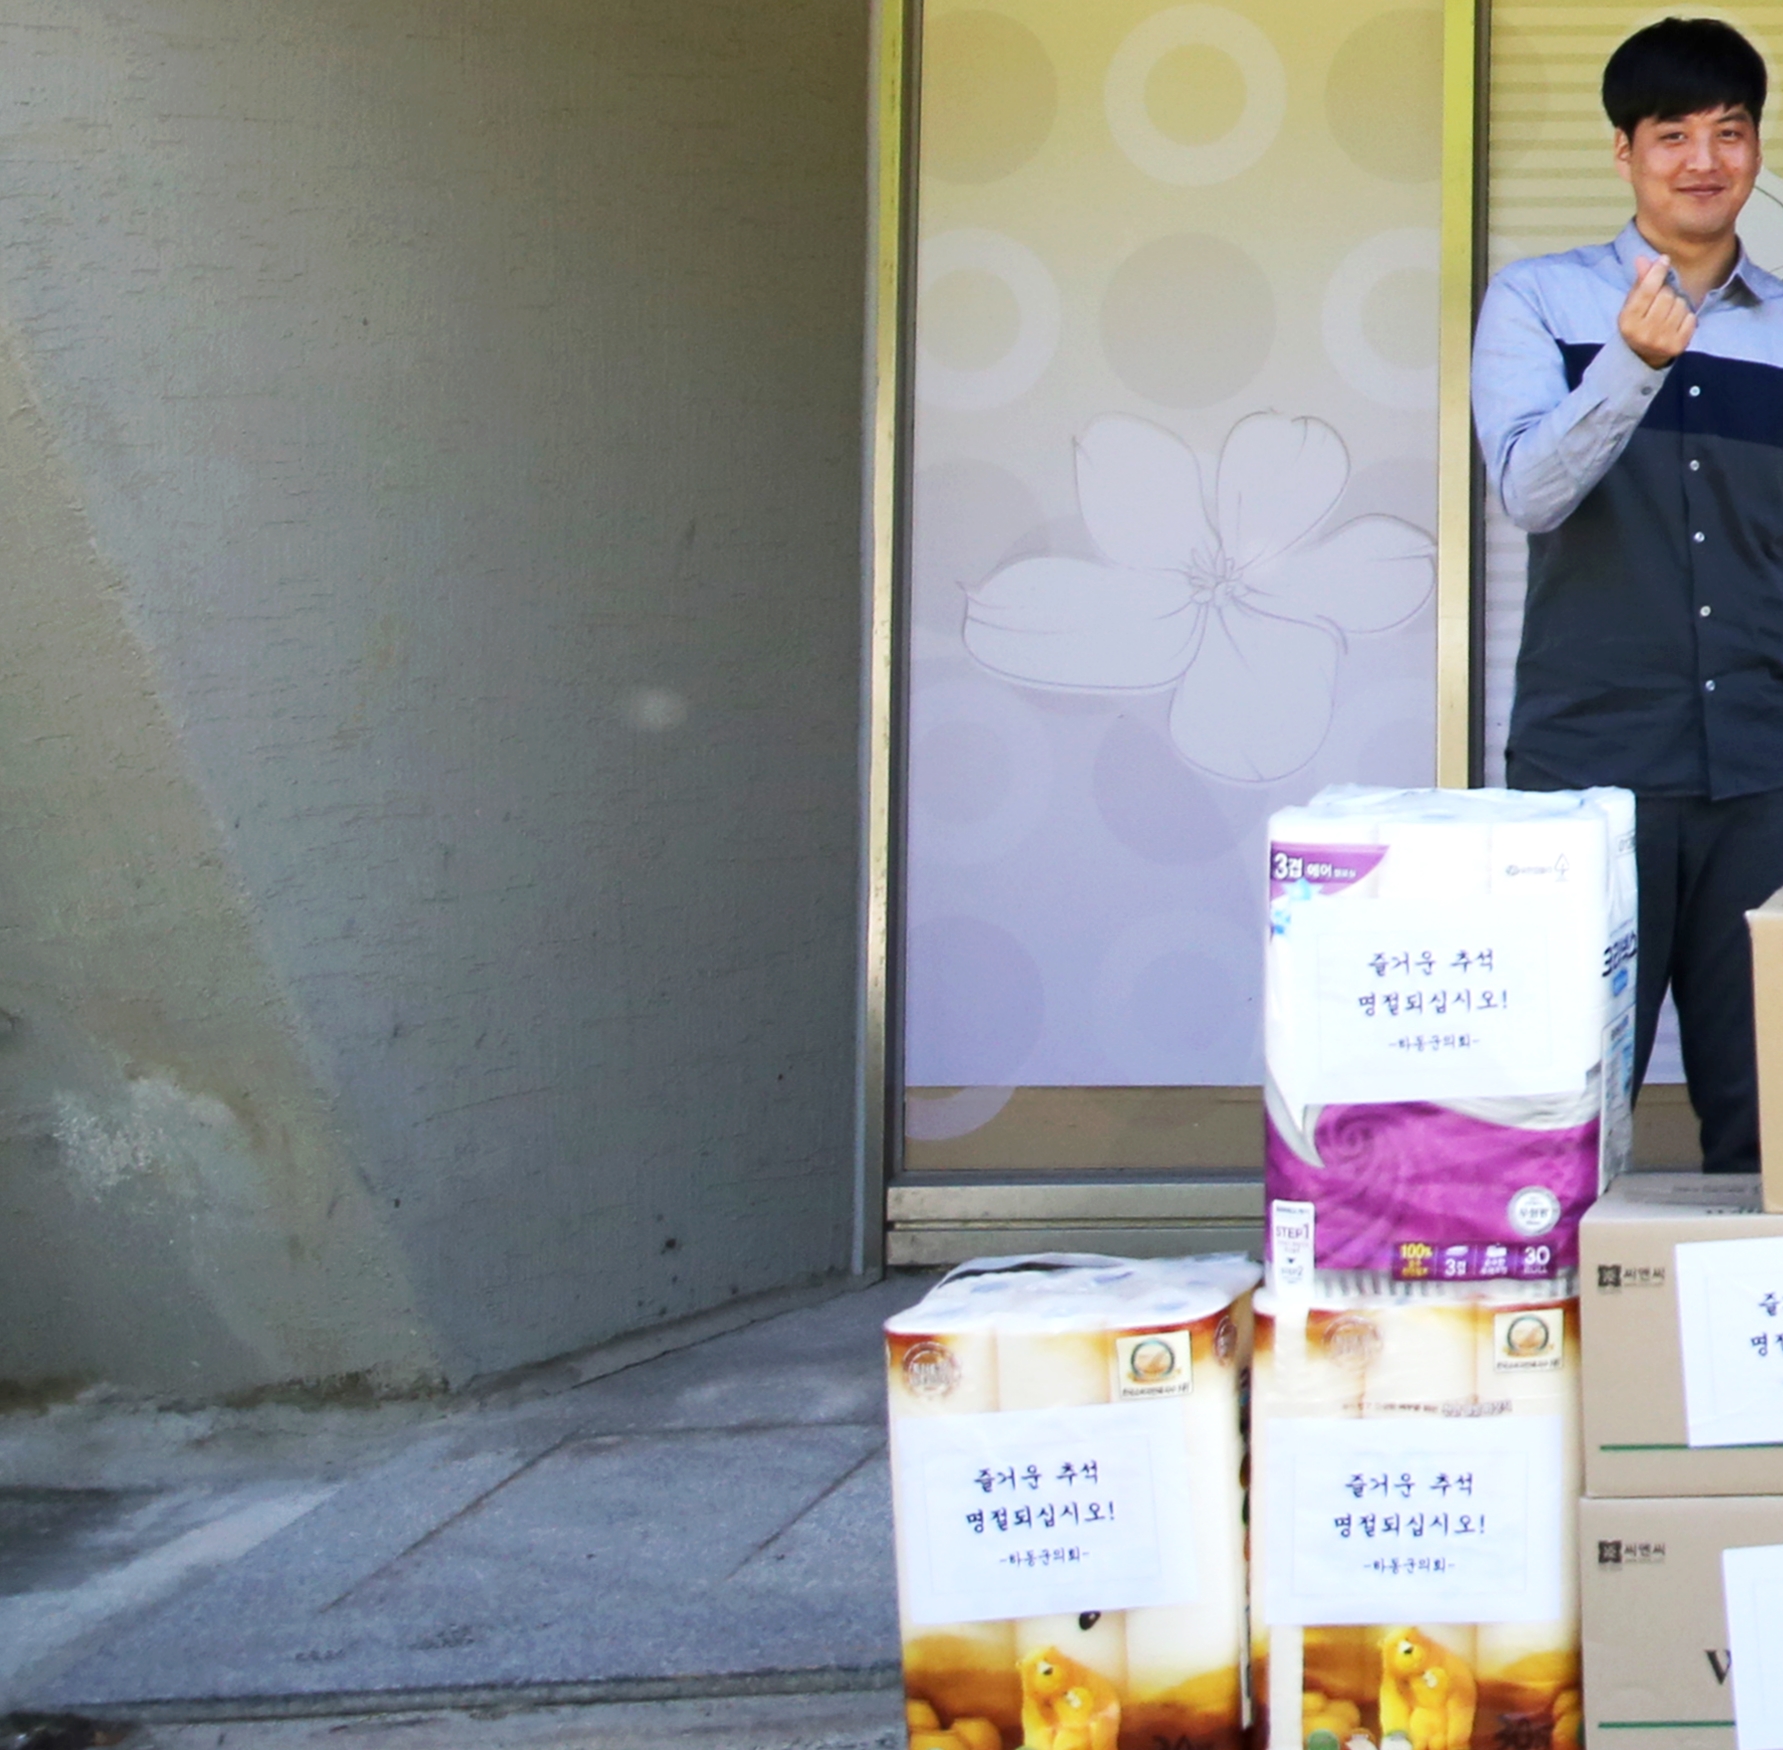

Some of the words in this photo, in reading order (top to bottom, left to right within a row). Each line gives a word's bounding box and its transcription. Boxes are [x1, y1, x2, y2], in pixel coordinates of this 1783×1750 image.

[1274, 853, 1303, 880] 3겹
[1307, 863, 1333, 878] 에어
[1368, 951, 1435, 977] 즐거운
[1451, 949, 1493, 972] 추석
[1358, 989, 1507, 1017] 명절되십시오!
[1523, 1245, 1550, 1263] 30
[974, 1465, 1041, 1493] 즐거운
[1057, 1461, 1097, 1485] 추석
[1345, 1473, 1415, 1498] 즐거운
[1430, 1473, 1472, 1496] 추석
[966, 1502, 1114, 1533] 명절되십시오!
[1334, 1513, 1484, 1538] 명절되십시오!
